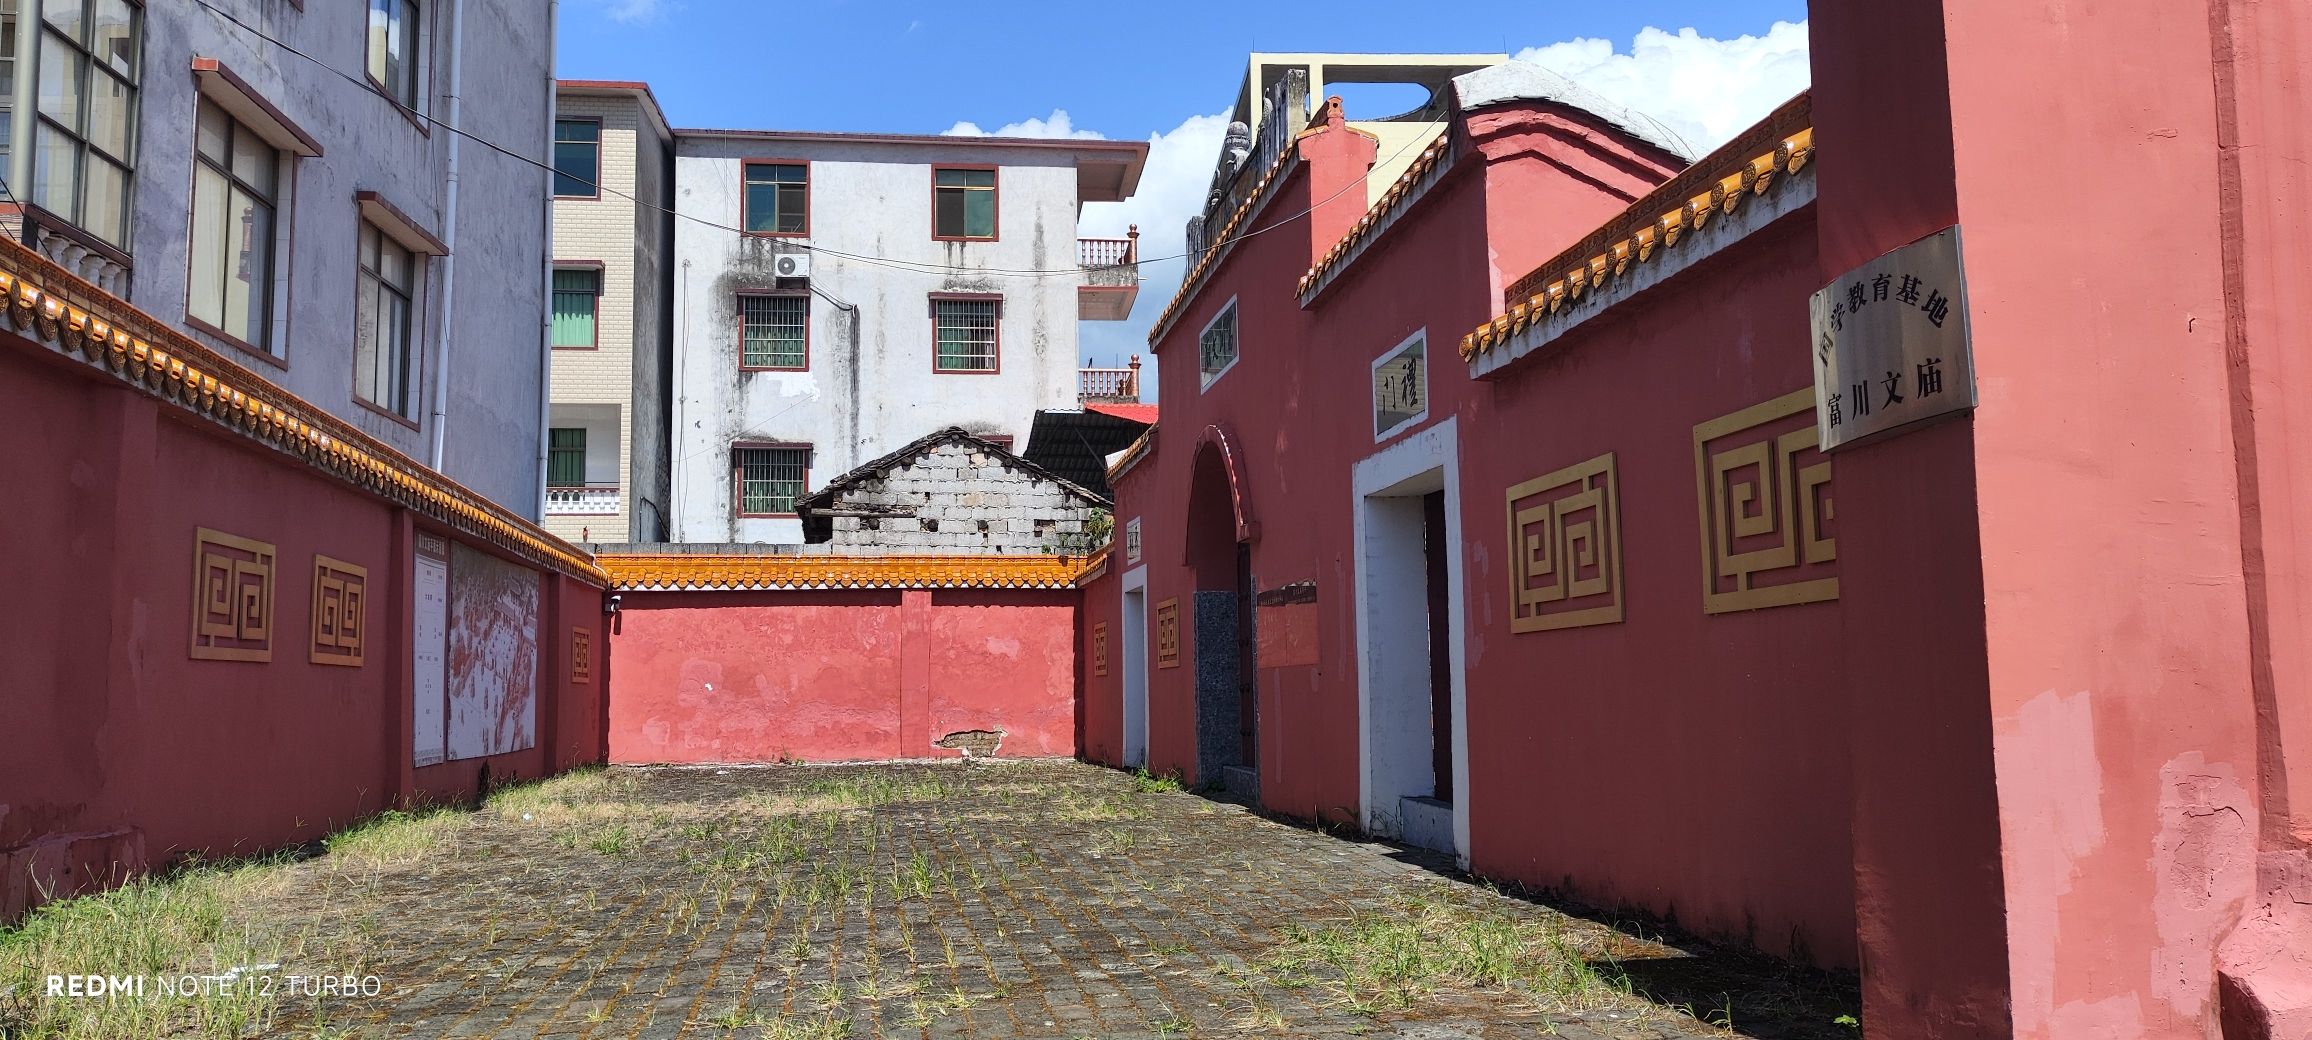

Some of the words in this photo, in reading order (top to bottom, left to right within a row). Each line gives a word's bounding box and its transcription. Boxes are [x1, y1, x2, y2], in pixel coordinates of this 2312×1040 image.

[1818, 272, 1949, 367] 国学教育基地
[1827, 357, 1944, 430] 富川文庙
